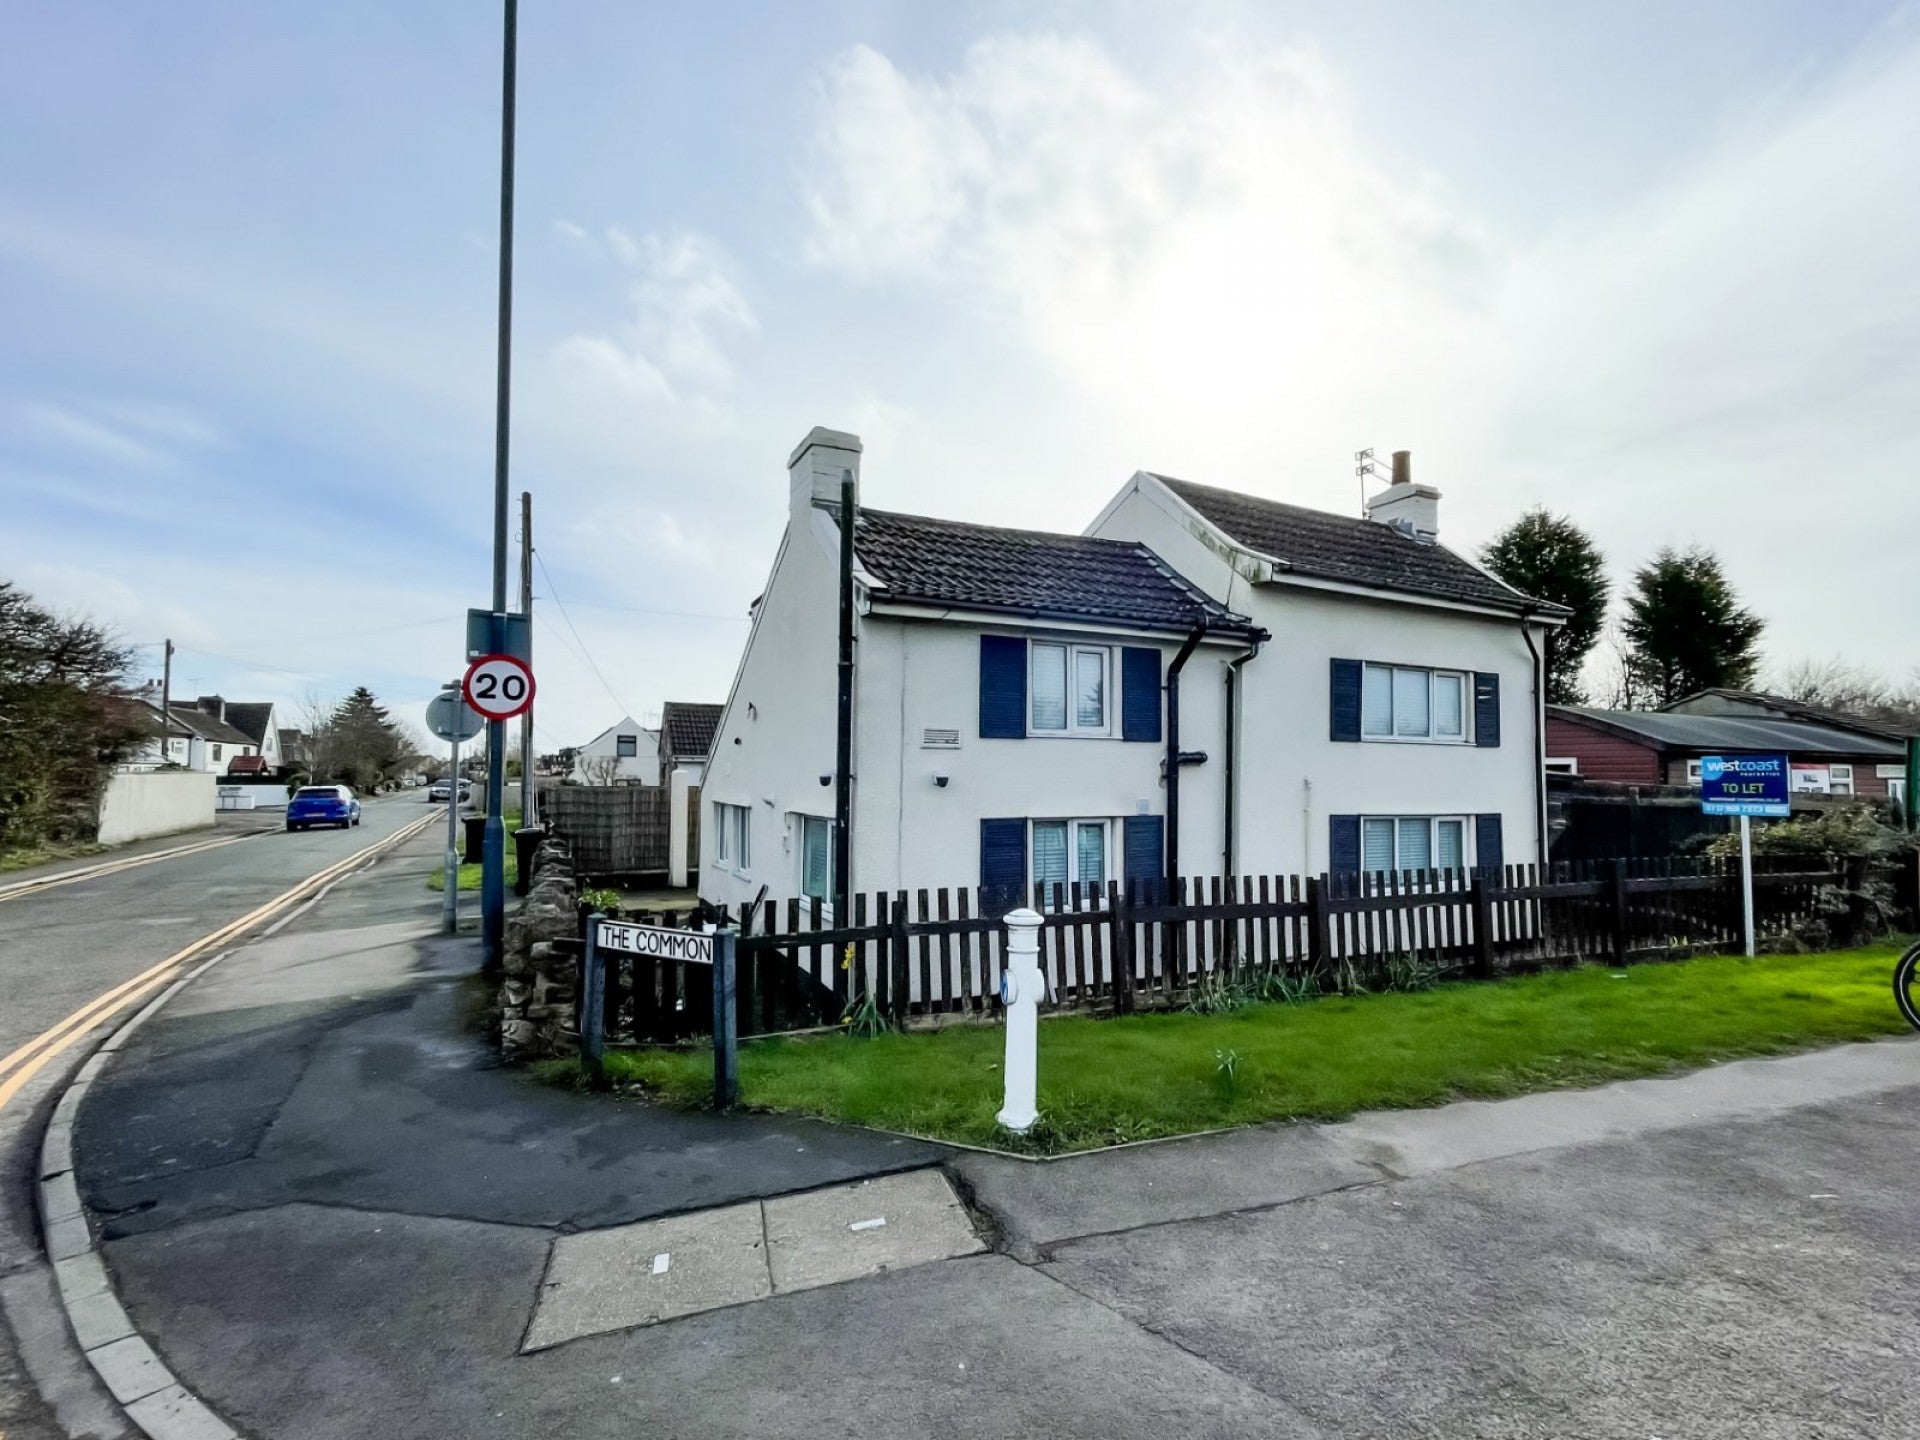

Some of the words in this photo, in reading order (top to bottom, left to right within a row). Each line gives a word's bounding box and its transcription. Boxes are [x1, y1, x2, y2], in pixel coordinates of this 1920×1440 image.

[476, 673, 525, 701] 20
[1706, 760, 1780, 772] westcoast
[1721, 783, 1739, 793] TO
[1742, 783, 1765, 794] LET
[603, 926, 630, 949] THE
[636, 931, 711, 961] COMMON
